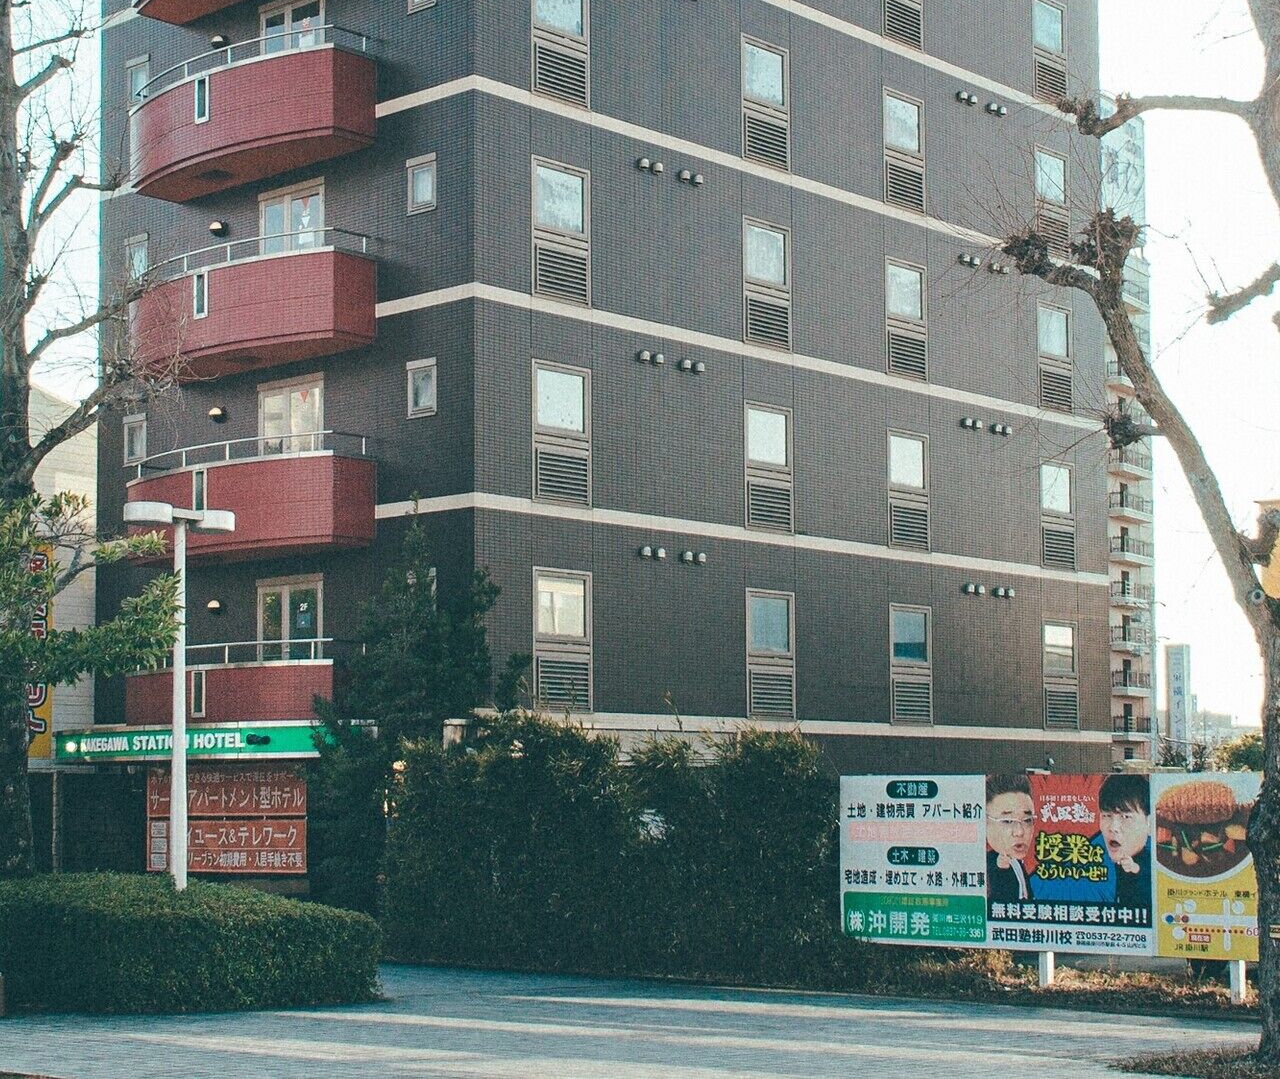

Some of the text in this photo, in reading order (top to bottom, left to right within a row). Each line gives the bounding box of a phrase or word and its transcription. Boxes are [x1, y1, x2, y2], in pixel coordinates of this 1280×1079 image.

[80, 732, 246, 752] KAKEGAWA STATI HOTEL
[150, 787, 304, 809] サーアパートメント型ホテル
[896, 782, 929, 796] 不動産
[847, 803, 983, 819] 土地・建物売買 アパート紹介
[1036, 831, 1104, 864] 授業は
[991, 902, 1148, 924] 無料受験相談受付中!!
[991, 927, 1072, 945] 武田塾掛川校
